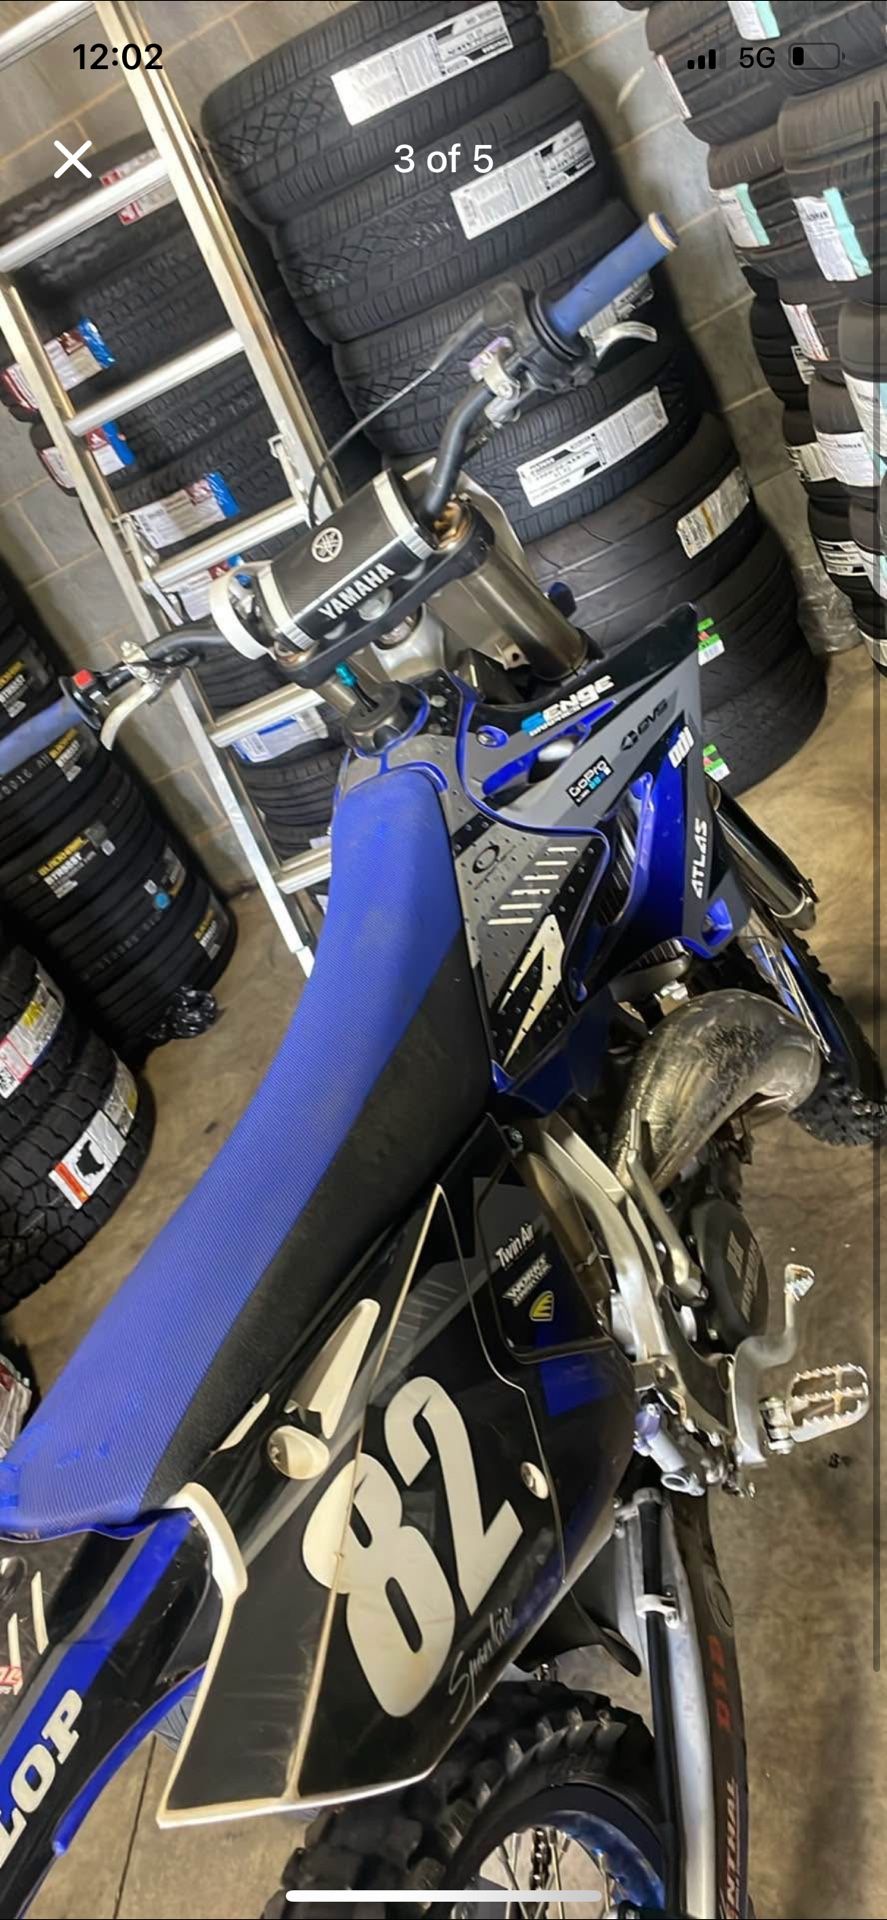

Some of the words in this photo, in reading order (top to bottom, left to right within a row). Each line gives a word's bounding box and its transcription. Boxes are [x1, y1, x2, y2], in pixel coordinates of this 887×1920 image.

[318, 563, 396, 619] YAMAHA
[568, 760, 608, 798] GoPro
[691, 817, 708, 899] ATLAS
[495, 1236, 523, 1269] Twin
[520, 1222, 535, 1247] Air
[302, 1376, 524, 1717] 82
